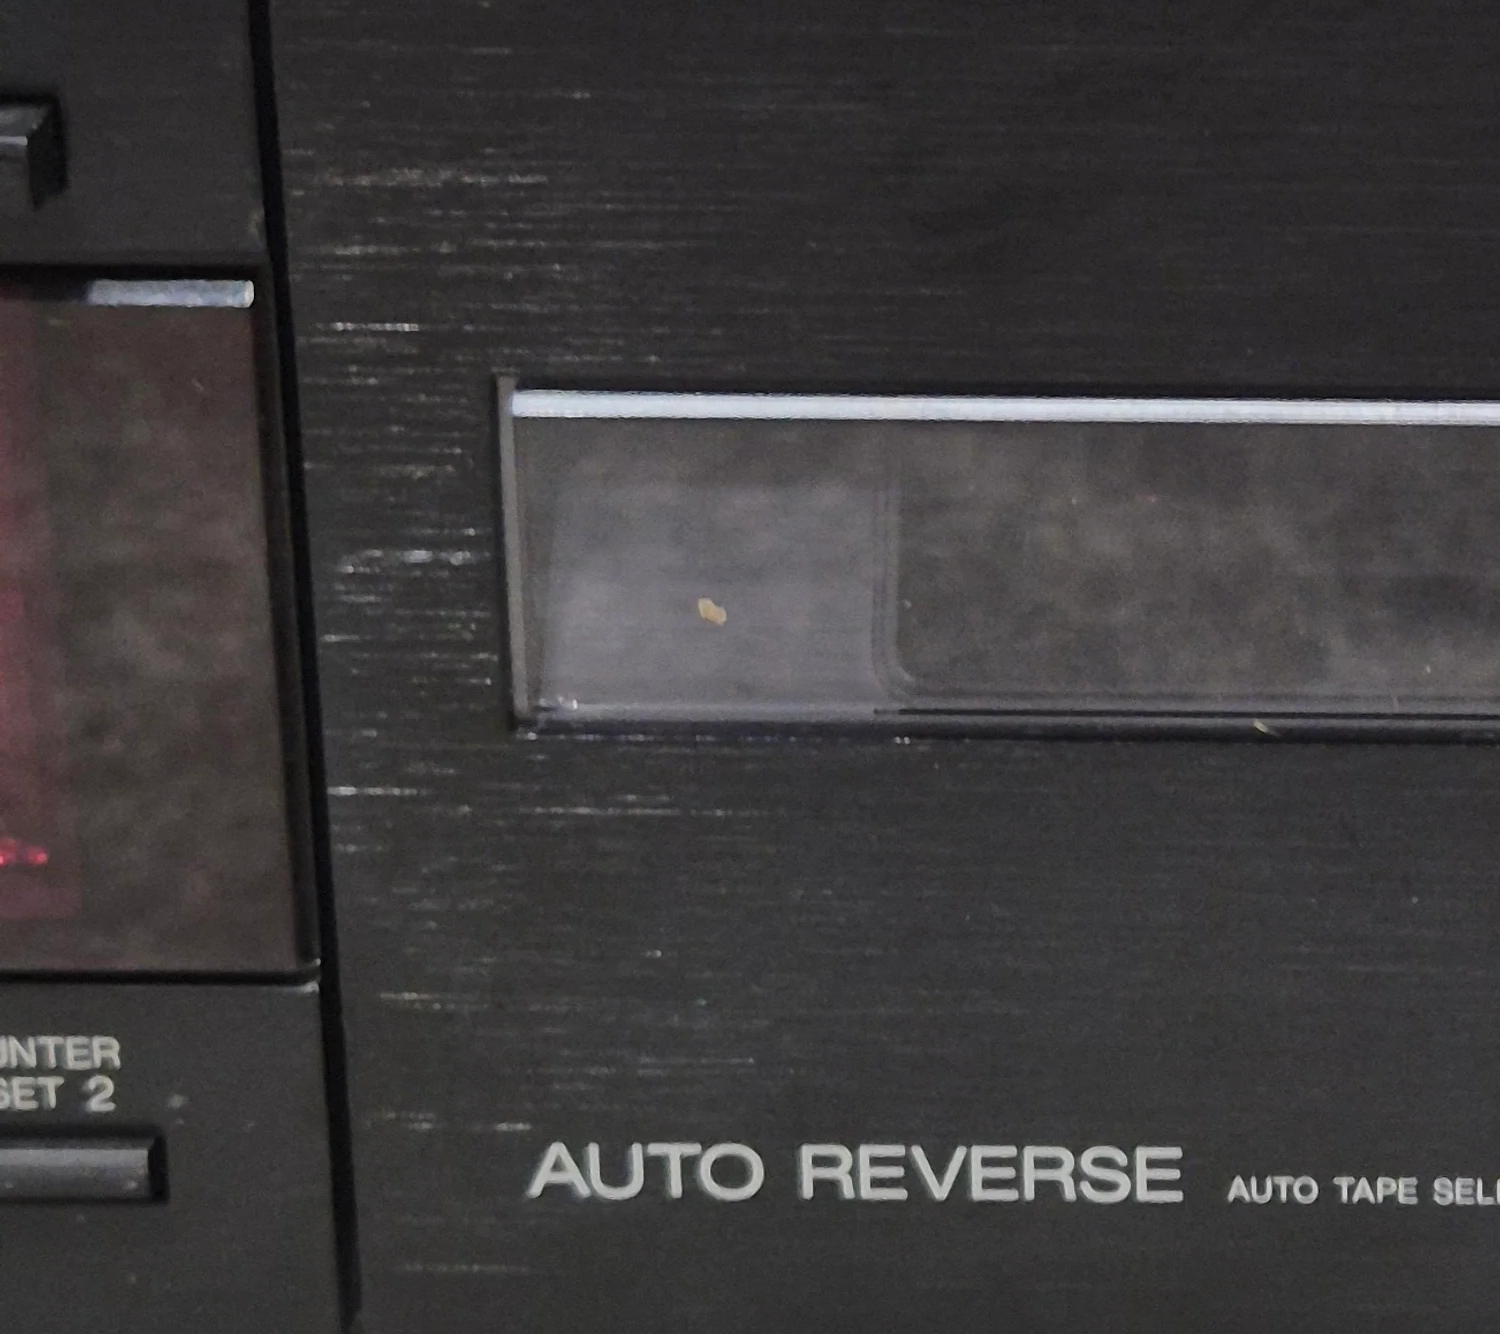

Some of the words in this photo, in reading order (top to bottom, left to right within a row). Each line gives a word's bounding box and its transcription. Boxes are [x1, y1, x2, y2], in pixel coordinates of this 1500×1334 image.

[0, 1035, 121, 1070] NTER
[86, 1076, 116, 1112] 2
[527, 1141, 765, 1201] AUTO
[800, 1143, 1184, 1204] REVERSE
[1227, 1175, 1320, 1205] AUTO
[1333, 1176, 1419, 1206] TAPE
